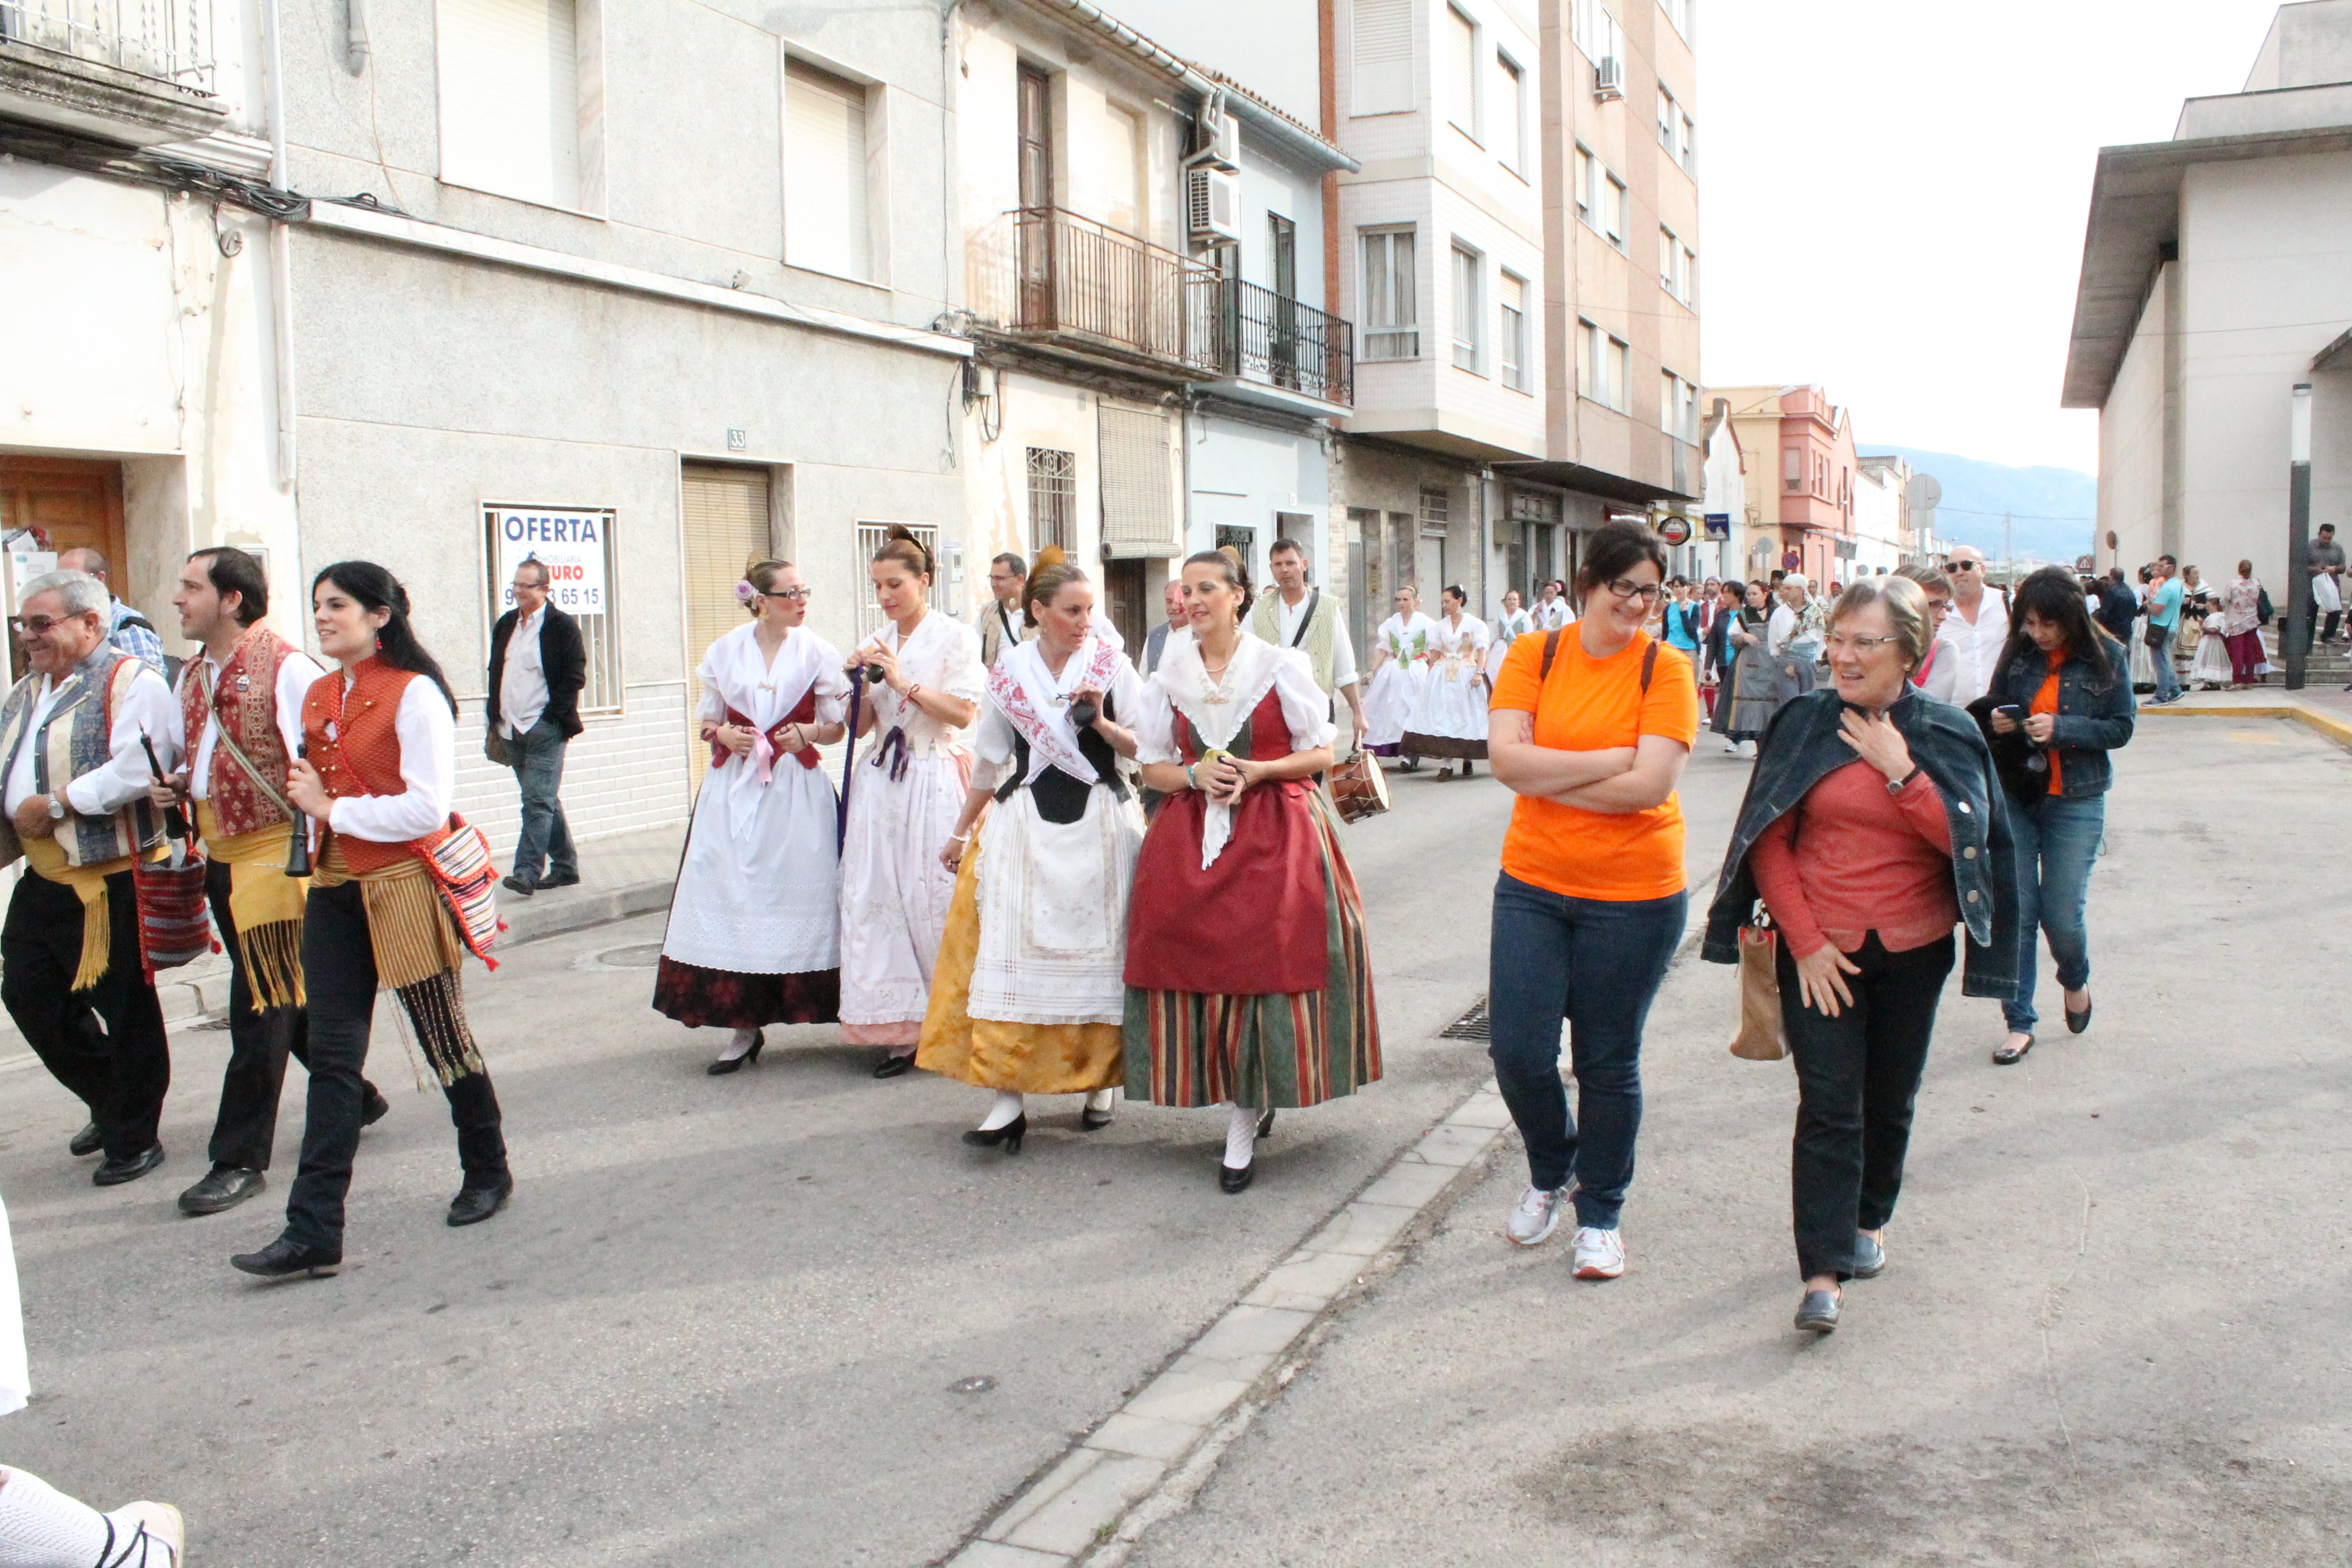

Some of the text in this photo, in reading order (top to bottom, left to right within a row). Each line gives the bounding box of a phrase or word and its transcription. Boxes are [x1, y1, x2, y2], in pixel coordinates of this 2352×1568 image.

[731, 431, 745, 447] 33
[505, 516, 598, 542] OFERTA
[562, 589, 578, 605] 65
[584, 588, 598, 605] 15
